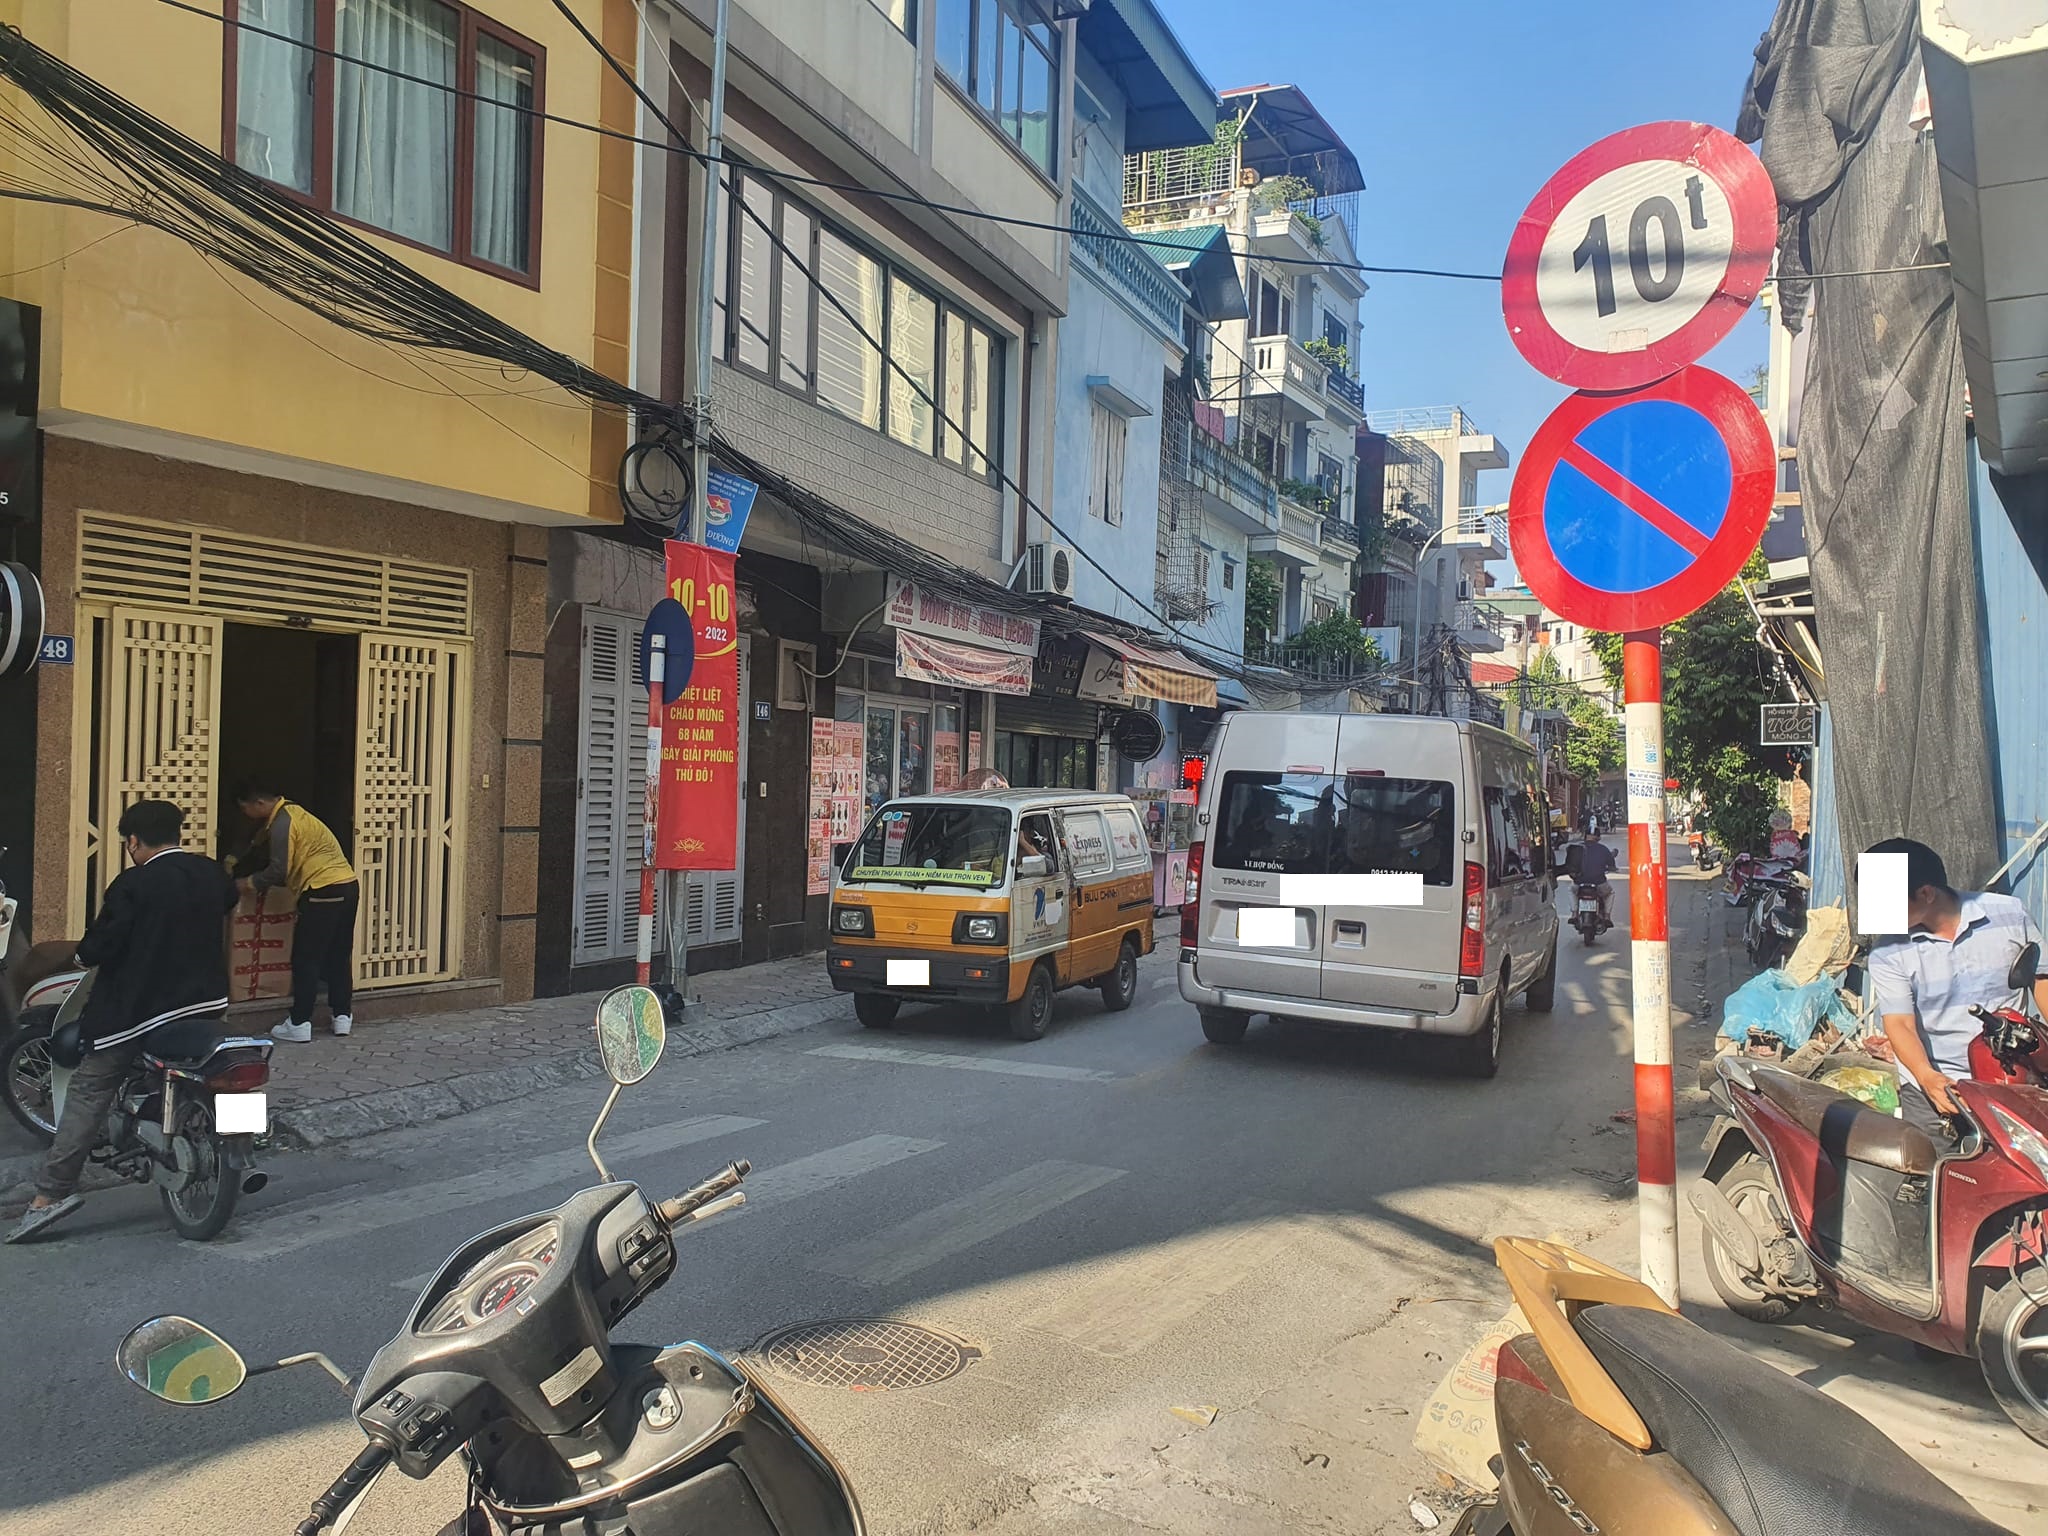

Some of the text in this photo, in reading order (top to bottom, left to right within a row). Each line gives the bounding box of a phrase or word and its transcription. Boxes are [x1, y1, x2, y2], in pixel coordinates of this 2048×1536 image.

[705, 625, 727, 641] 2022
[40, 639, 68, 659] 48
[703, 686, 721, 705] LIỆT
[670, 704, 724, 722] CHÀO MỪNG
[756, 704, 769, 718] 146
[679, 727, 714, 742] 68 NĂM
[683, 744, 701, 761] GIẢI
[704, 747, 734, 763] PHÓNG
[676, 765, 693, 781] THỦ
[1221, 877, 1267, 888] TRANSIT
[1948, 1169, 1978, 1185] HONDA
[1514, 1439, 1600, 1534] LEAD
